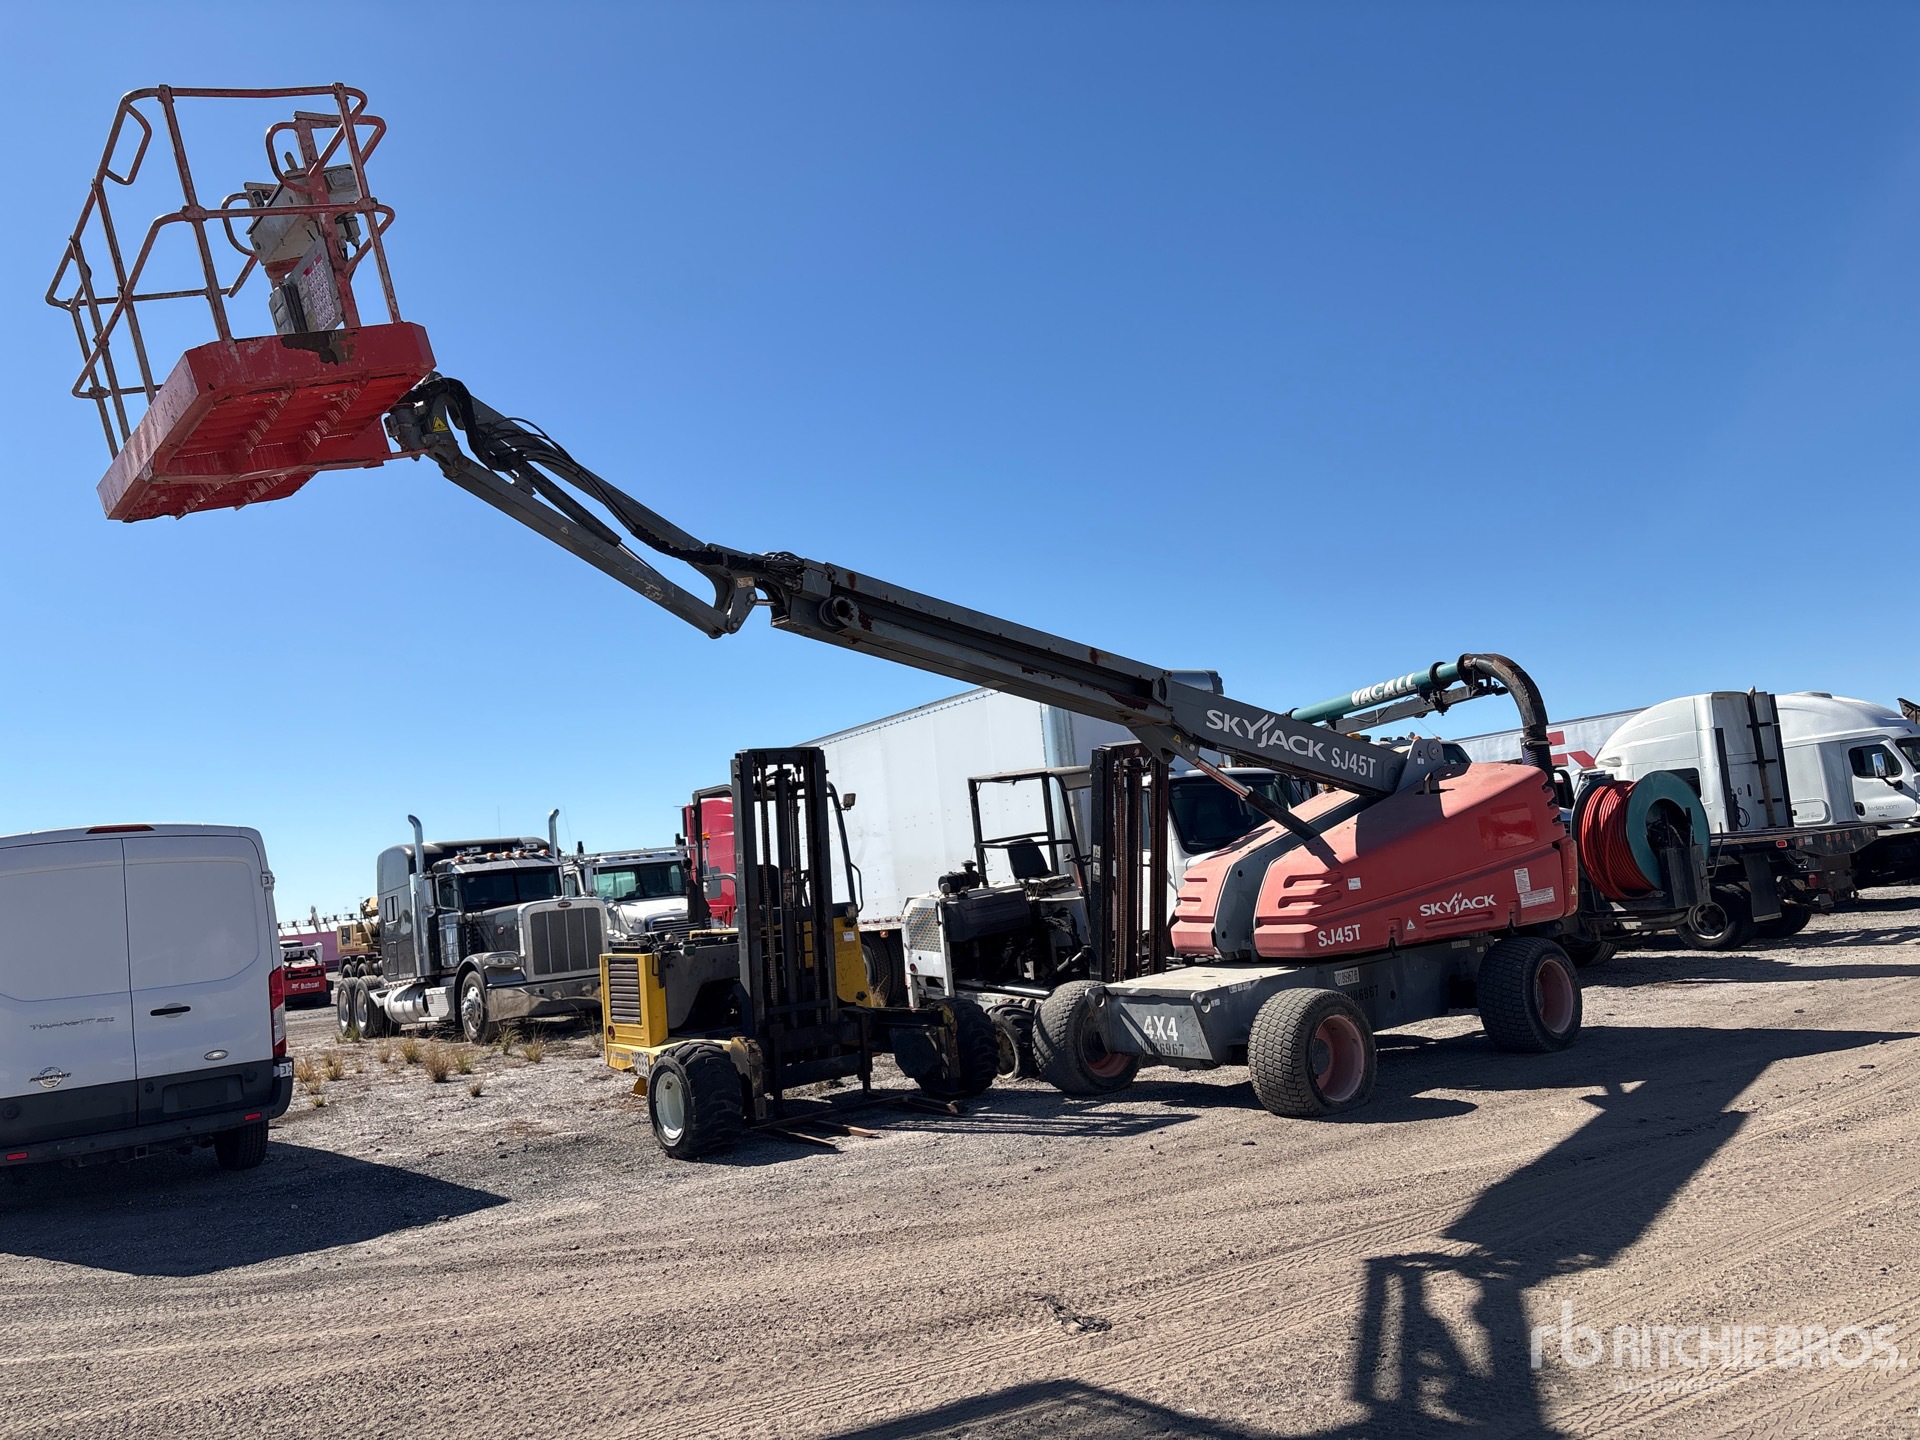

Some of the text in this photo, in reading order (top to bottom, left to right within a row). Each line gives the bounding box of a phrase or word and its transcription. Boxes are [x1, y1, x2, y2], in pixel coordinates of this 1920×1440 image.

[1351, 673, 1417, 706] VACALL
[1206, 709, 1376, 778] SKYJACK SJ45T
[1420, 892, 1497, 916] SKYJACK
[1318, 924, 1361, 947] SJ45T
[1143, 1015, 1179, 1041] 4X4
